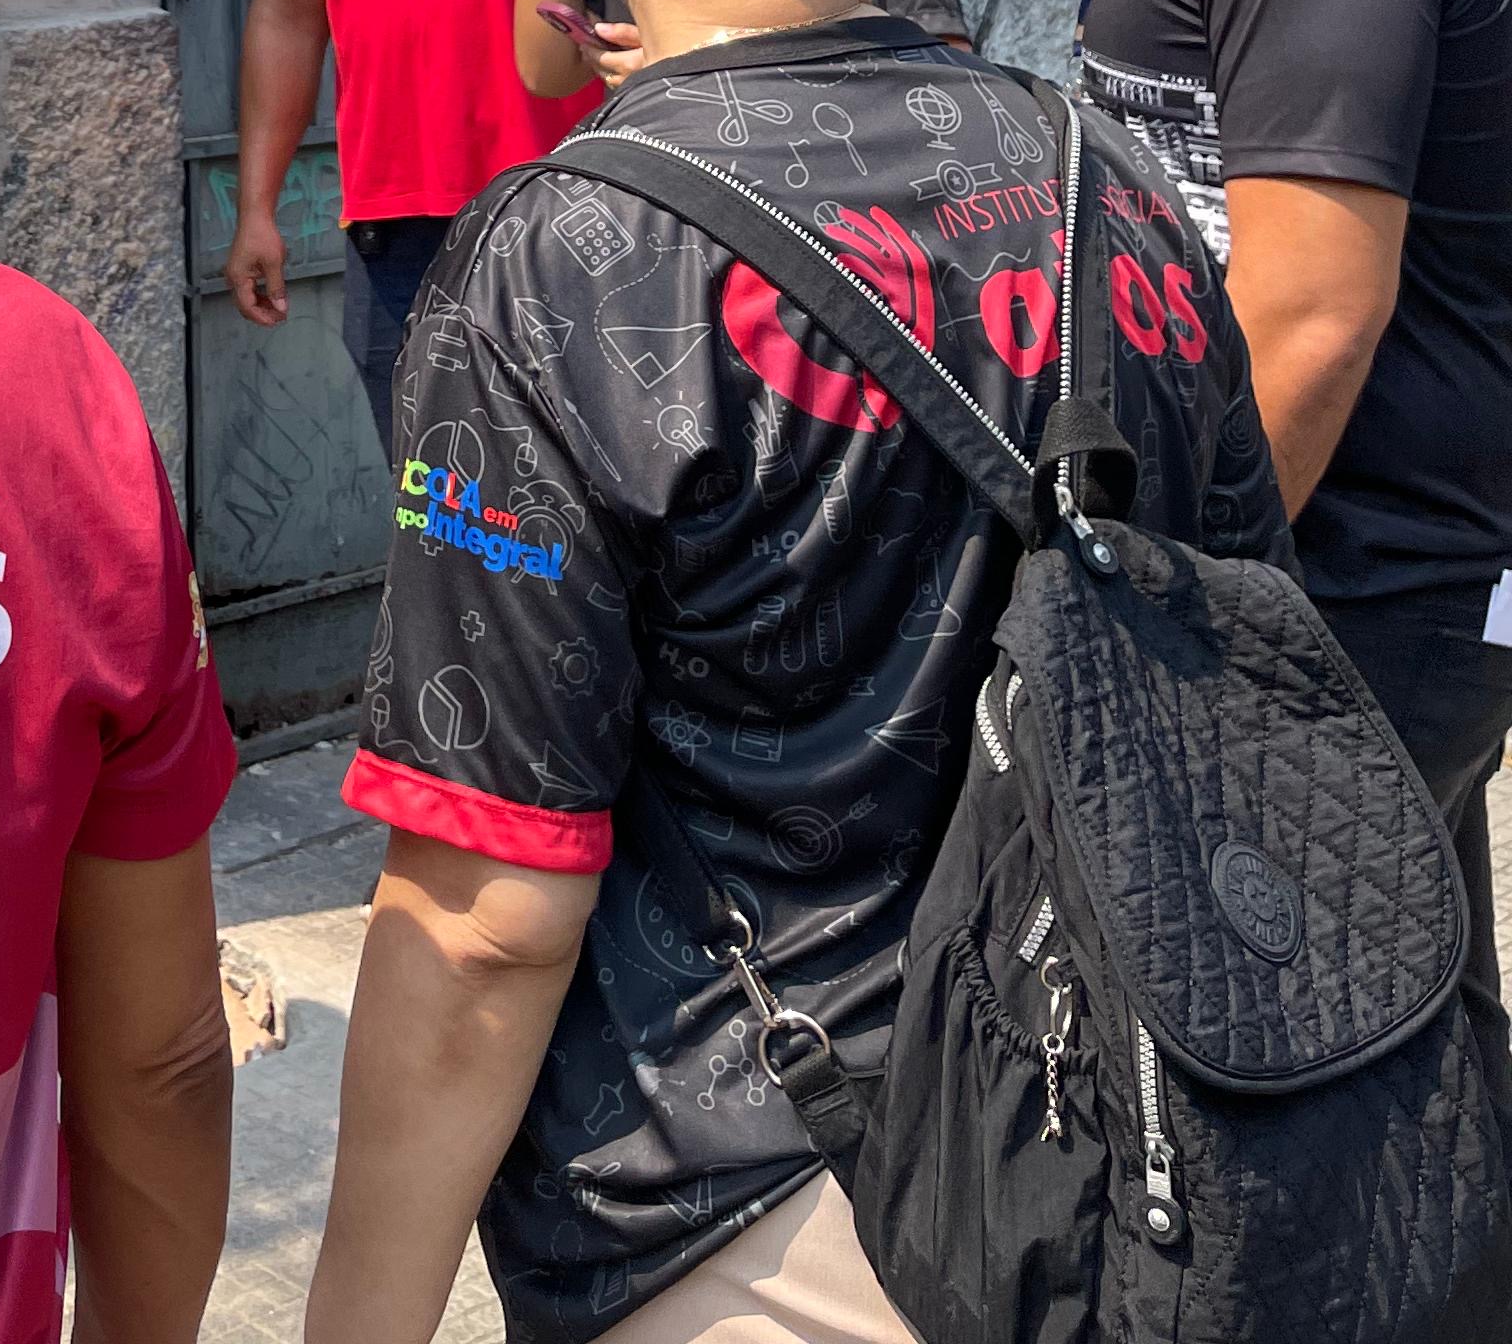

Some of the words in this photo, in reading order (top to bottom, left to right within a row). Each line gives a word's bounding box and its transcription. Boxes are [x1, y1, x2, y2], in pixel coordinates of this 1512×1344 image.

[934, 178, 1064, 241] INSTITU
[980, 229, 1208, 378] aos
[424, 500, 564, 581] Integral
[483, 506, 519, 531] em
